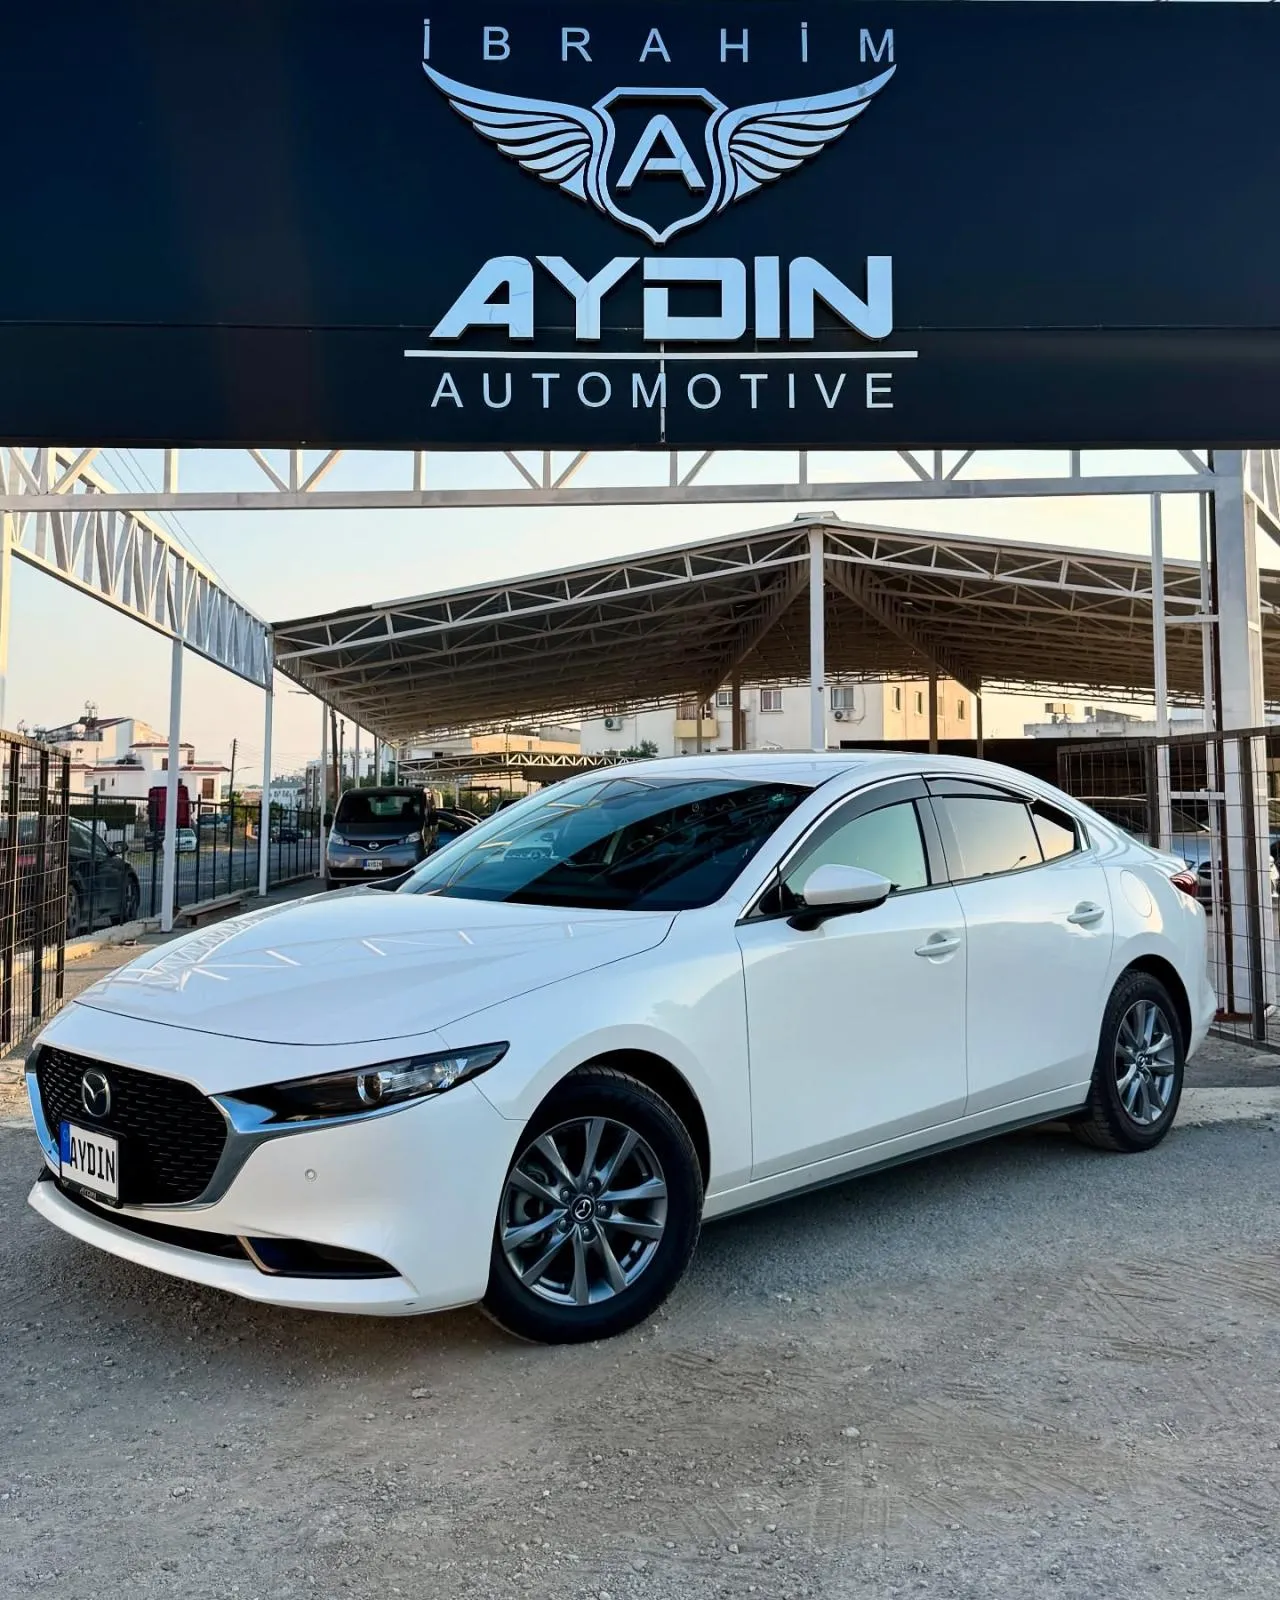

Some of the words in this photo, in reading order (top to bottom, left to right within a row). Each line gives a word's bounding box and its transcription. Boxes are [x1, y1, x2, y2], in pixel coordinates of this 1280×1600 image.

[422, 19, 895, 62] İBRAHİM
[615, 113, 706, 191] A
[428, 255, 894, 340] AYDIN
[430, 371, 894, 409] AUTOMOTIVE
[70, 1136, 115, 1184] AYDIN
